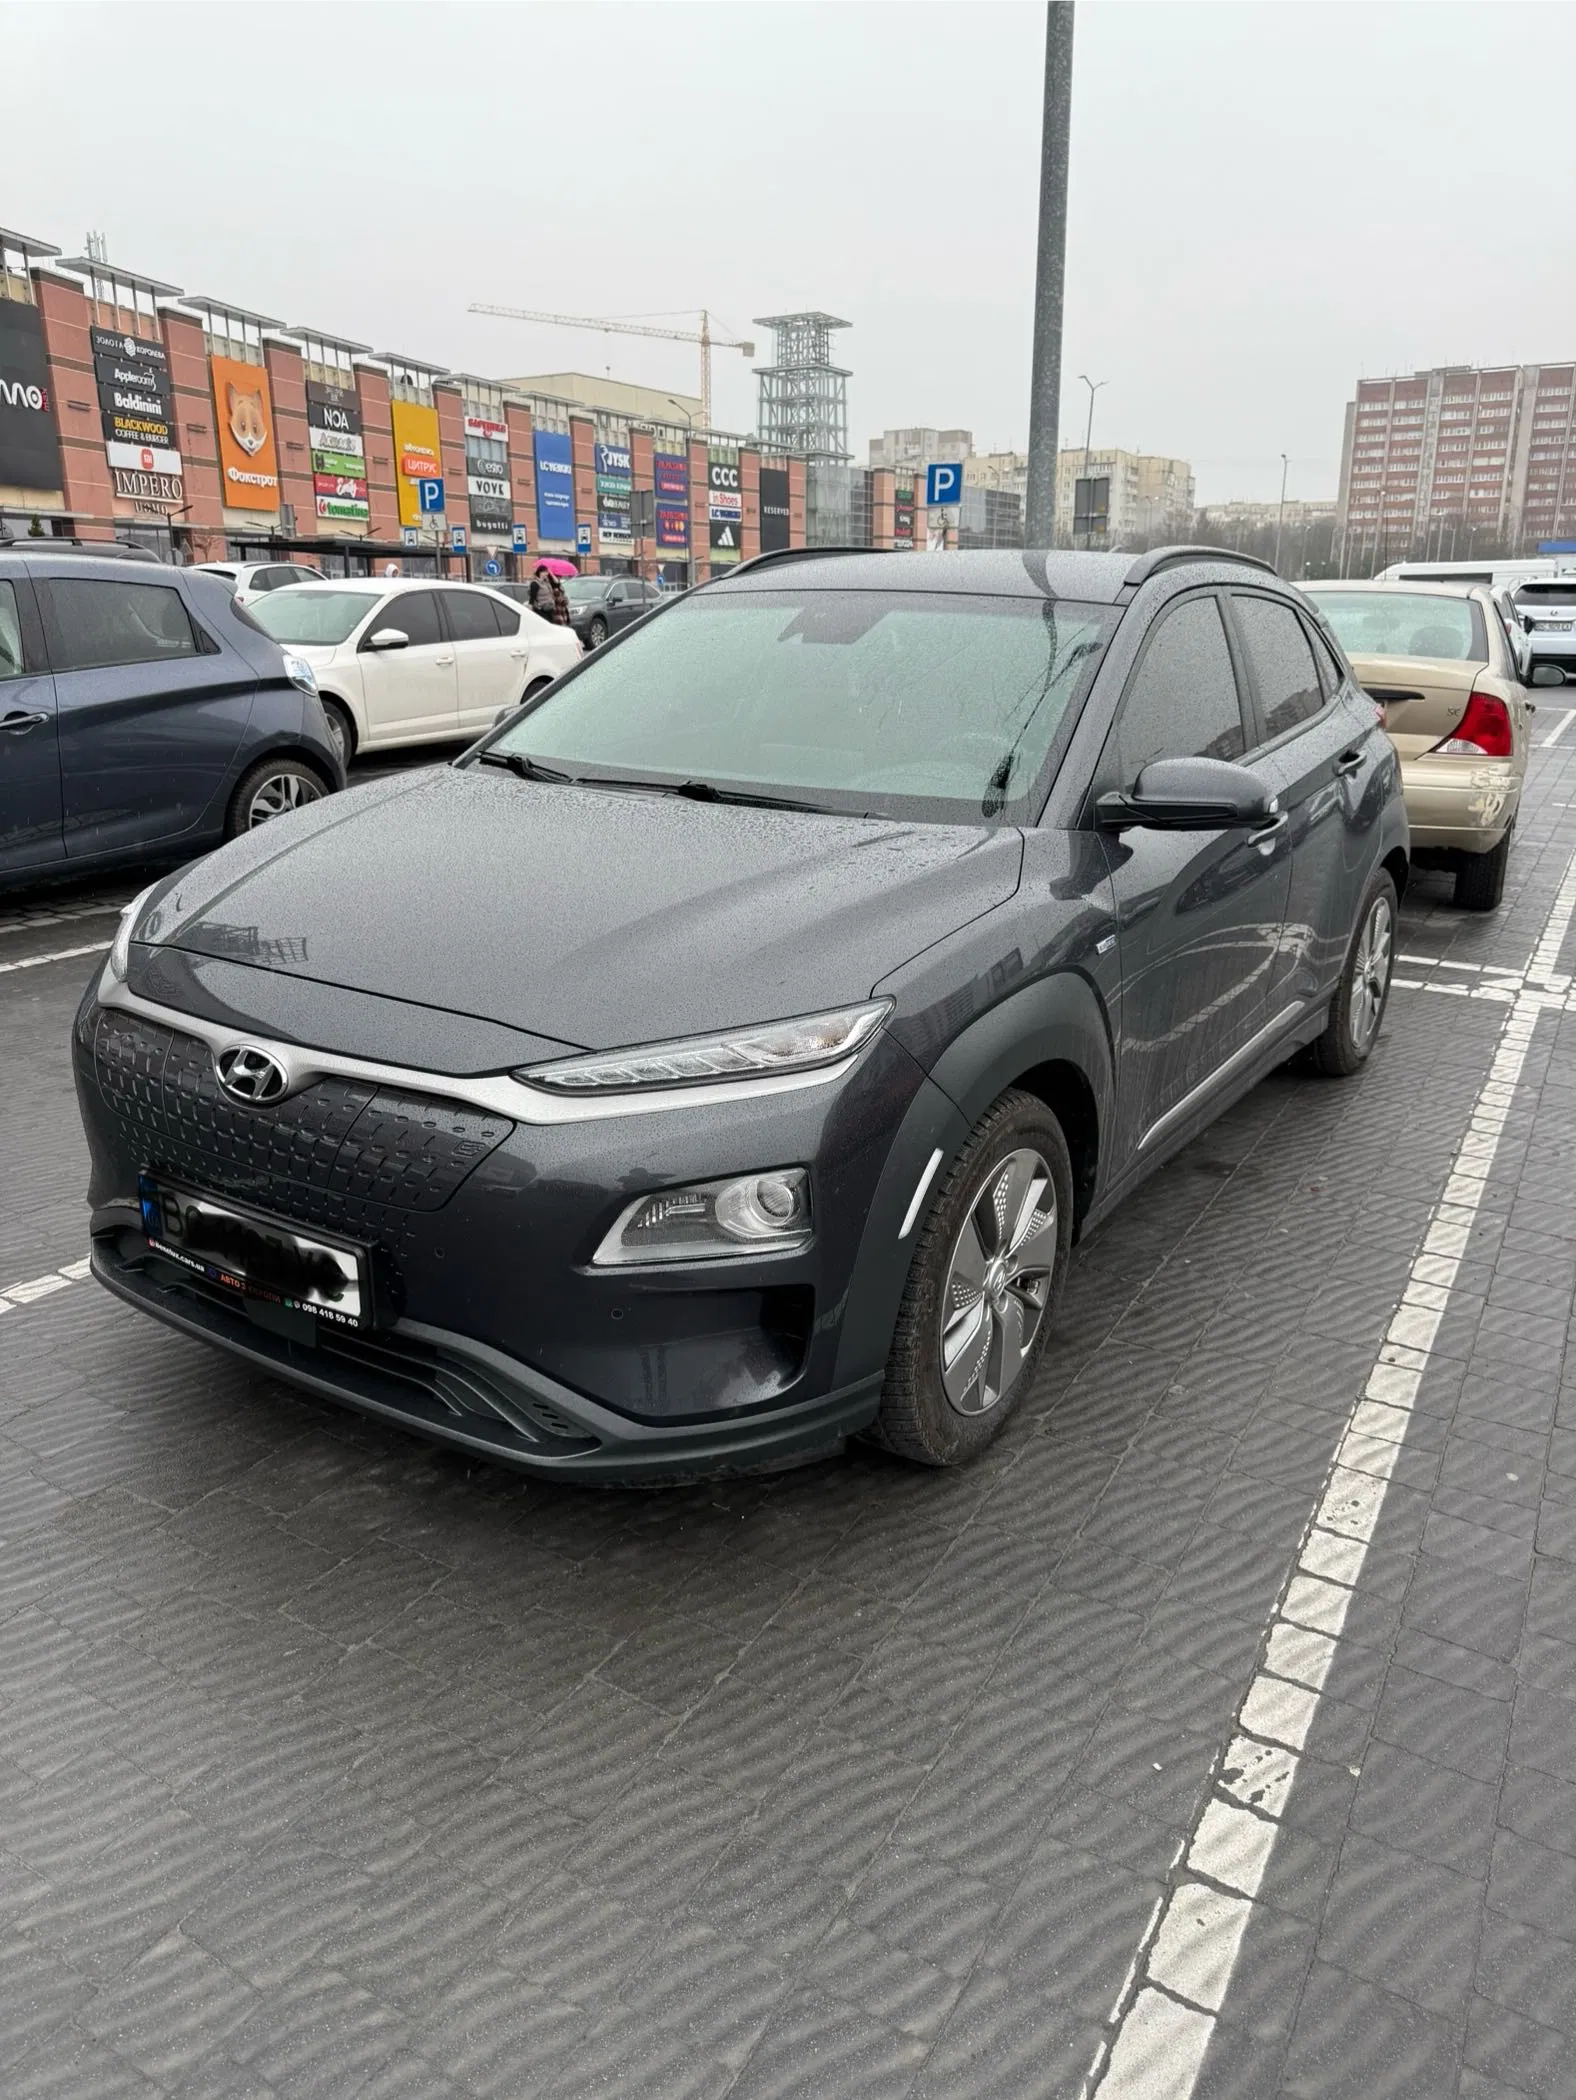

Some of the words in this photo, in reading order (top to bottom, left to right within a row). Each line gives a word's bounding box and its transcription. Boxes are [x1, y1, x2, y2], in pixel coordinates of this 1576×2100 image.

[113, 368, 155, 388] Appleroom
[113, 392, 162, 415] Baldinini
[114, 416, 168, 435] BLACKWOOD
[115, 428, 140, 440] COFFEE
[145, 434, 169, 445] BURGER
[607, 451, 631, 469] JYSK
[115, 470, 183, 500] IMPERO
[711, 466, 738, 487] CCC
[934, 468, 955, 501] P
[424, 482, 439, 509] P
[476, 480, 504, 496] VOVK
[135, 501, 168, 515] UOMO
[763, 505, 790, 516] RESERVED
[476, 519, 509, 530] bugatti
[220, 1272, 241, 1288] АВТО
[302, 1303, 318, 1314] 098
[335, 1313, 346, 1324] 59
[347, 1317, 359, 1328] 40
